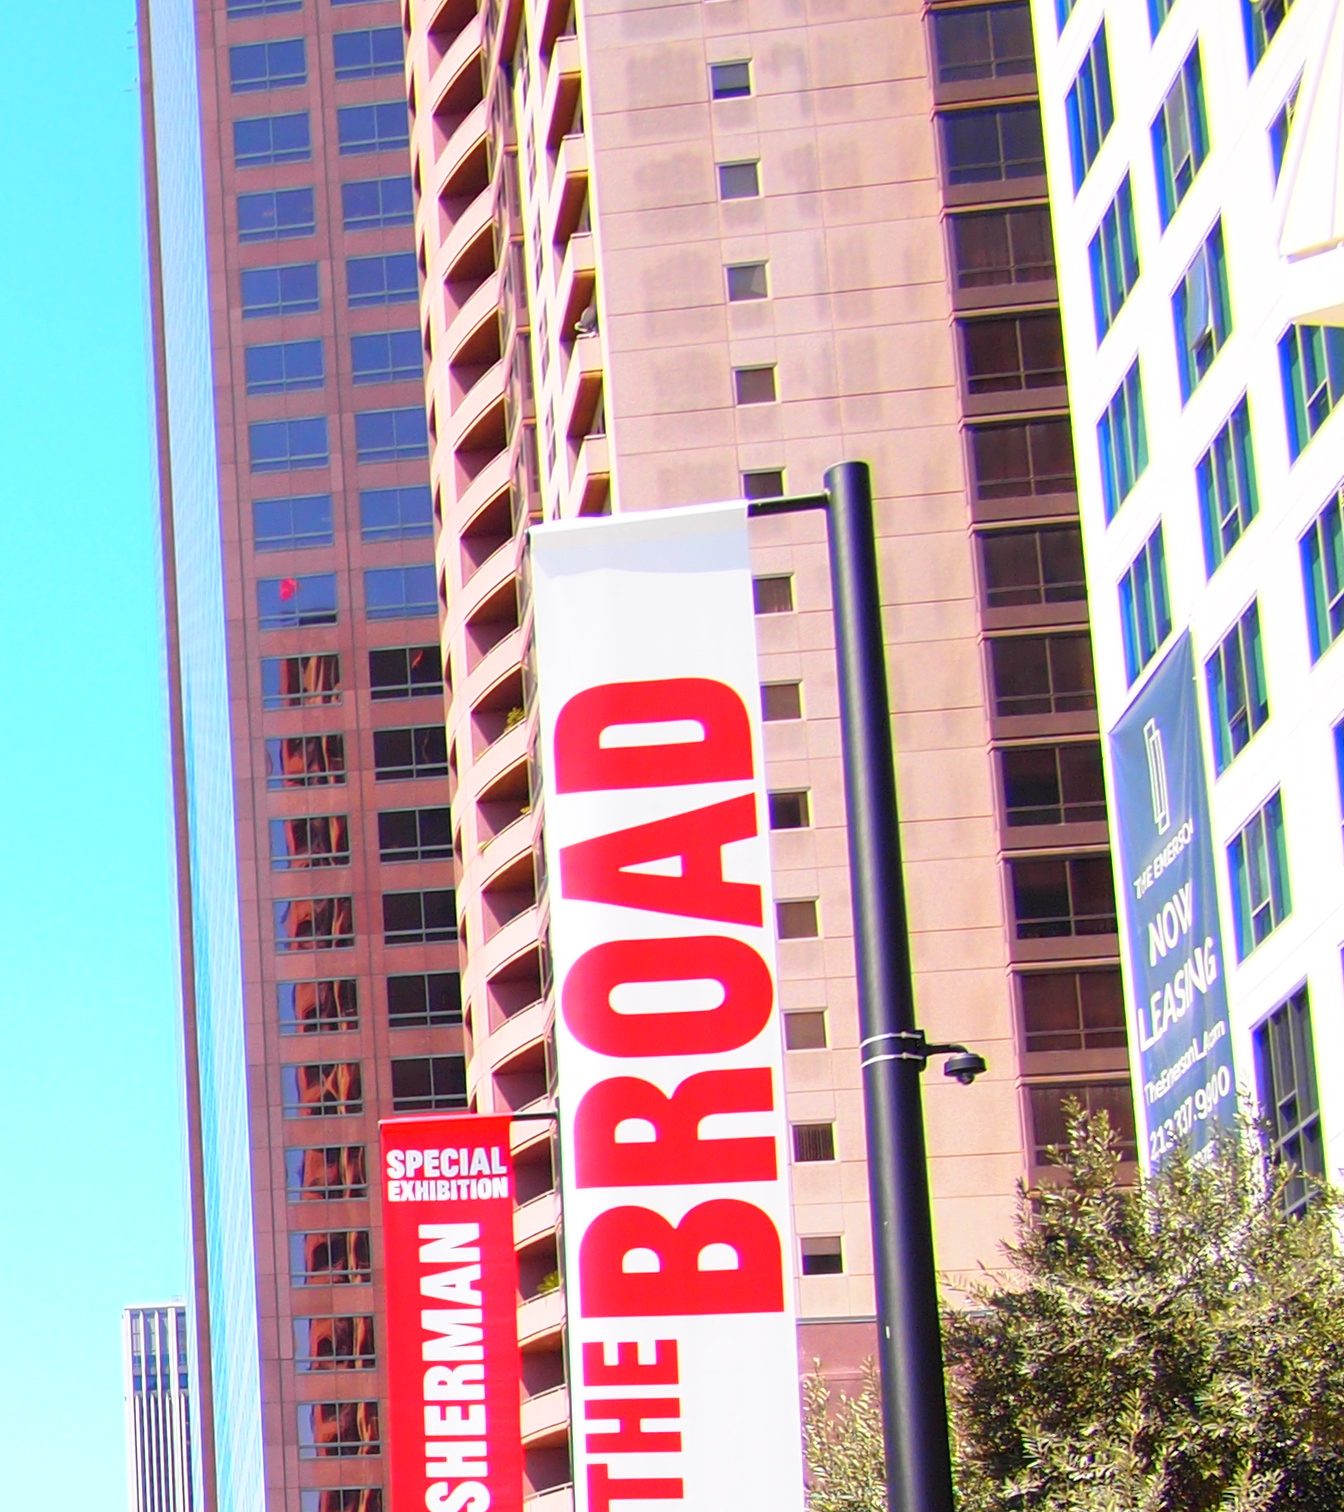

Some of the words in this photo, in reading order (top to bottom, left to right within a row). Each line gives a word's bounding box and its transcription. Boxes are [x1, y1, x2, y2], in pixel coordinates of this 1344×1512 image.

[1133, 864, 1154, 900] THE
[1148, 879, 1192, 968] NOW
[552, 676, 786, 1320] BROAD
[1138, 936, 1217, 1052] LEASING
[386, 1147, 508, 1179] SPECIAL
[387, 1177, 509, 1202] EXHIBITION
